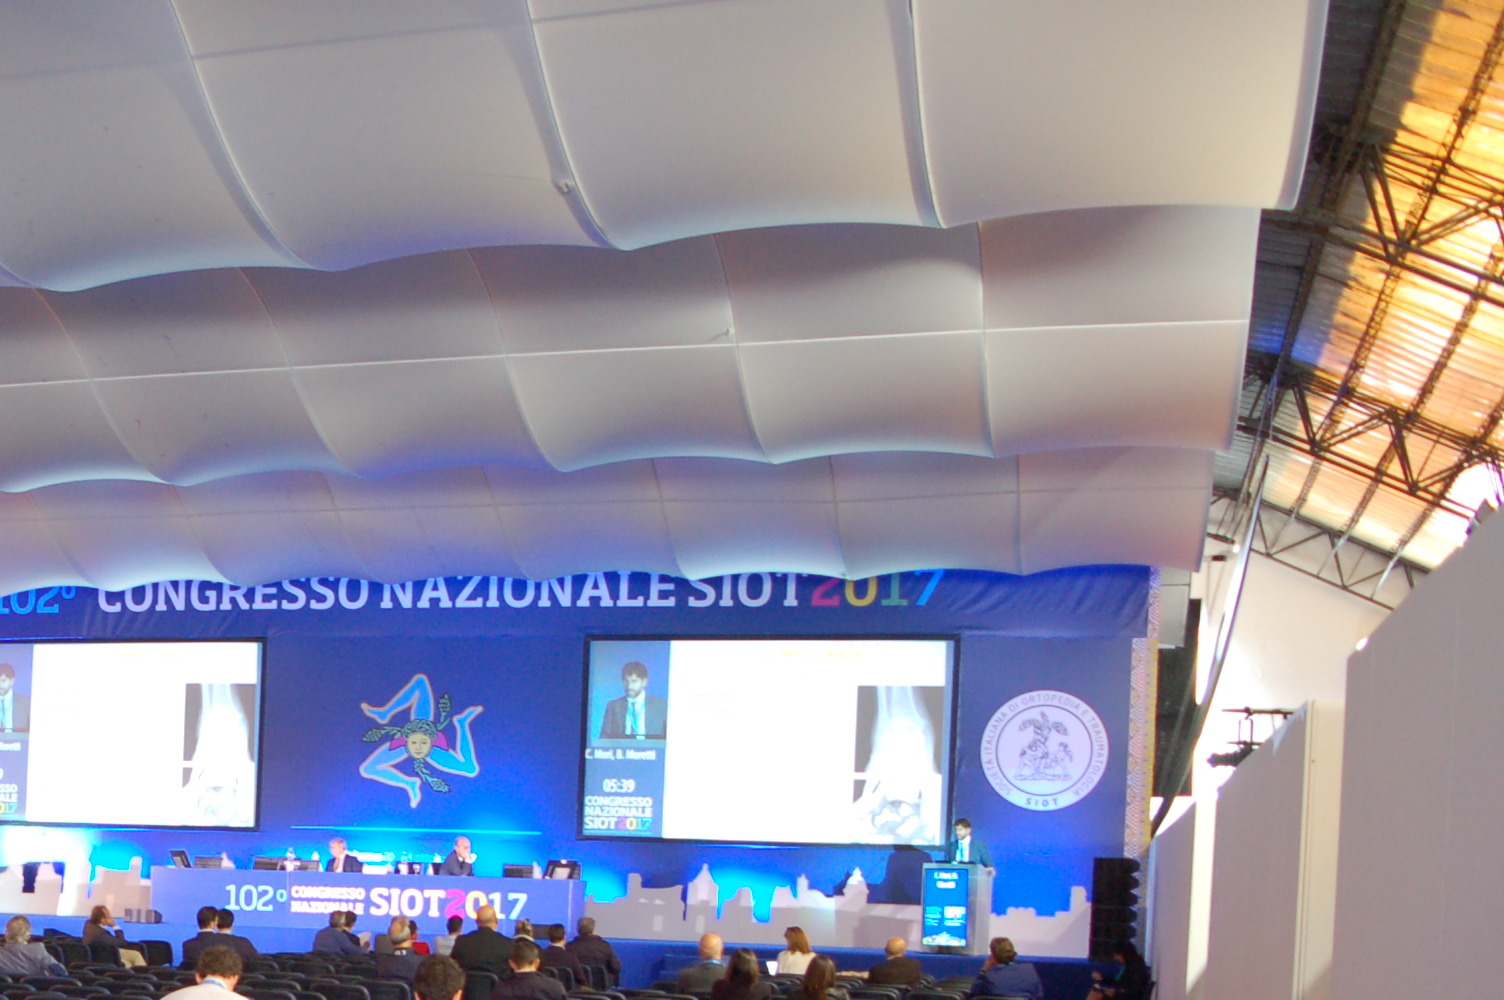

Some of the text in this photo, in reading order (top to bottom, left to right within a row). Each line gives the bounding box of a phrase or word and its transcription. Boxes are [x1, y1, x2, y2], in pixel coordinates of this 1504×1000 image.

[98, 577, 369, 613] CONGRESSO
[380, 571, 675, 609] NAZIONALE
[984, 711, 1009, 757] ITALIANA
[1008, 703, 1019, 712] DI
[1021, 693, 1081, 710] ORTOPEDIA
[1072, 717, 1106, 796] TRAUMATOLOGIA
[602, 778, 635, 793] 05:39
[584, 796, 653, 807] CONGRESSO
[1025, 797, 1059, 807] SIOT
[584, 806, 652, 818] NAZIONALE
[291, 885, 366, 900] CONGRESSO
[290, 900, 364, 915] NAZIONALE
